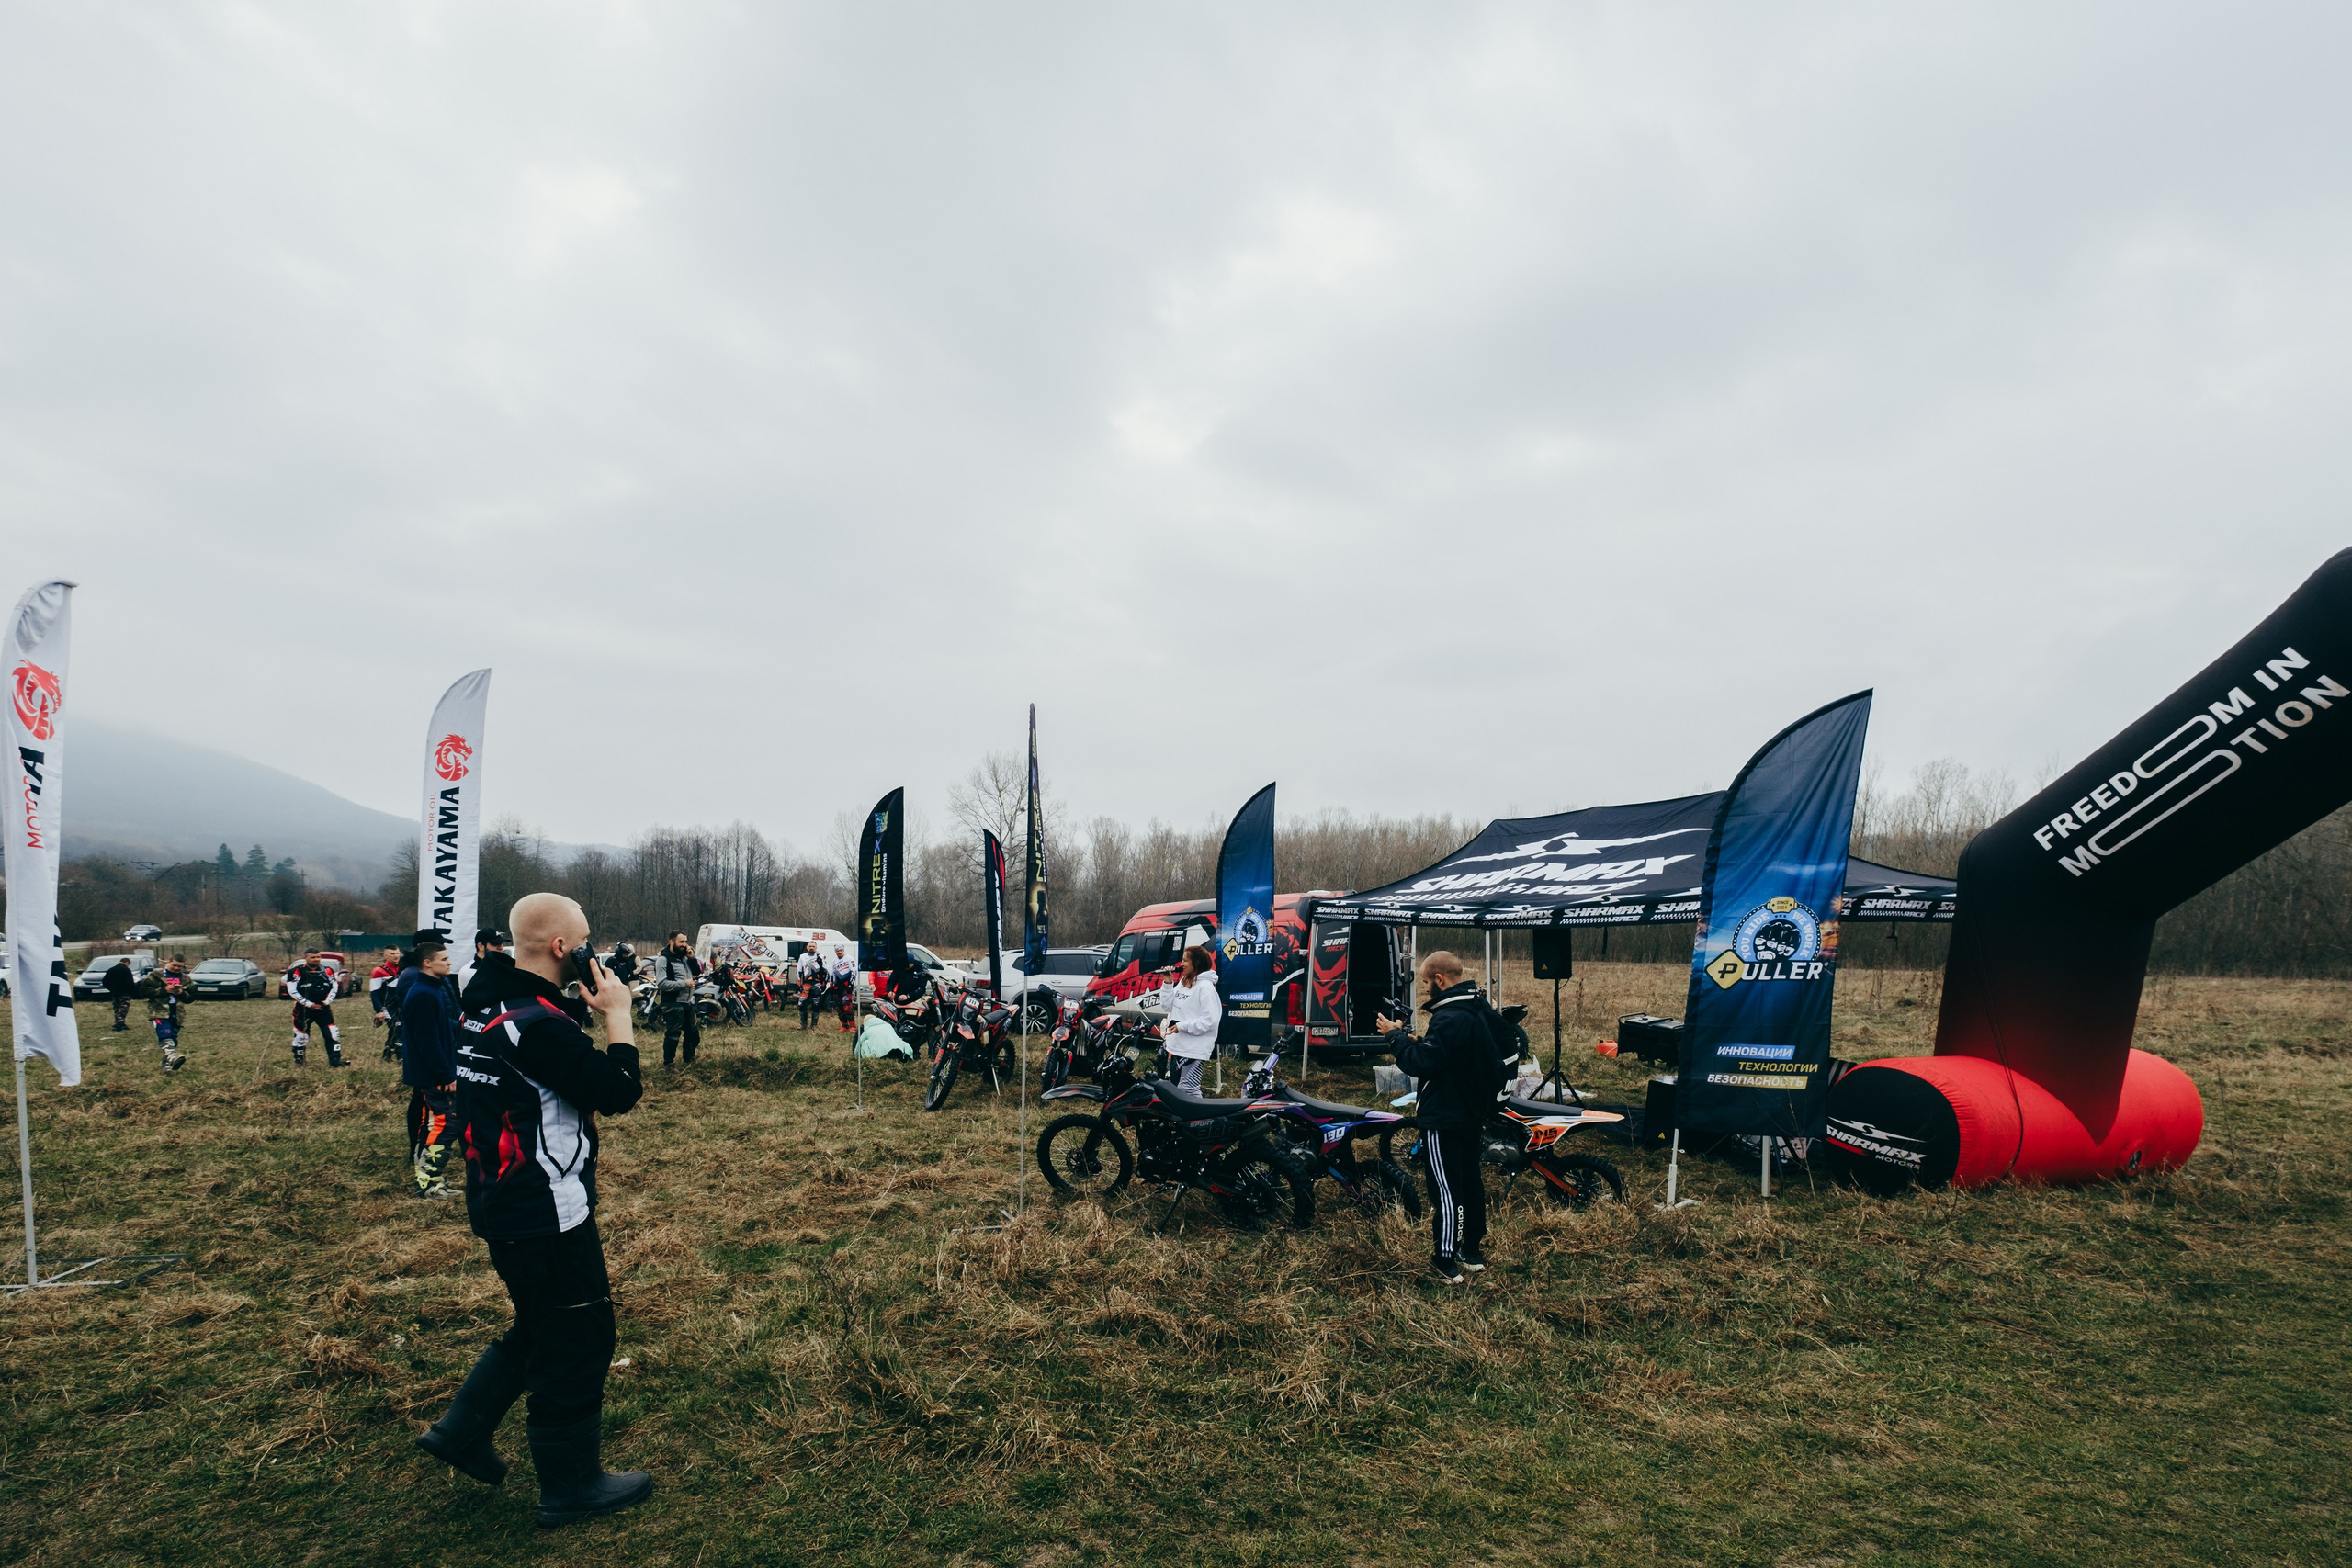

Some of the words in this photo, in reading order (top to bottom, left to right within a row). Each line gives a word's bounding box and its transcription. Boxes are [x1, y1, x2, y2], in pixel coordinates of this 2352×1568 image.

[2033, 686, 2256, 851] FREEDOM
[2253, 646, 2311, 692] IN
[2058, 674, 2351, 877] MOTION
[427, 812, 436, 852] MOTOR
[871, 833, 886, 914] NITREX
[1395, 854, 1696, 894] SHARMAX
[1316, 906, 1360, 915] SHARMAX
[1860, 898, 1933, 910] SHARMAX
[1364, 908, 1416, 918] SHARMAX
[1419, 911, 1477, 920] SHARMAX
[1483, 909, 1555, 920] SHARMAX
[1563, 905, 1645, 917] SHARMAX
[1792, 911, 1807, 926] WE
[1740, 937, 1751, 958] YOU
[1747, 911, 1770, 935] RIDE
[1799, 923, 1814, 958] WORK
[1322, 937, 1349, 947] SHAR
[1716, 1045, 1793, 1058] ИННОВАЦИИ
[1738, 1061, 1818, 1073] ТЕХНОЛОГИИ
[1707, 1074, 1804, 1087] БЕЗОПАСНОСТЬ
[1189, 1120, 1214, 1128] SPORT
[1323, 1126, 1346, 1143] 190
[1875, 1154, 1920, 1169] MOTORS
